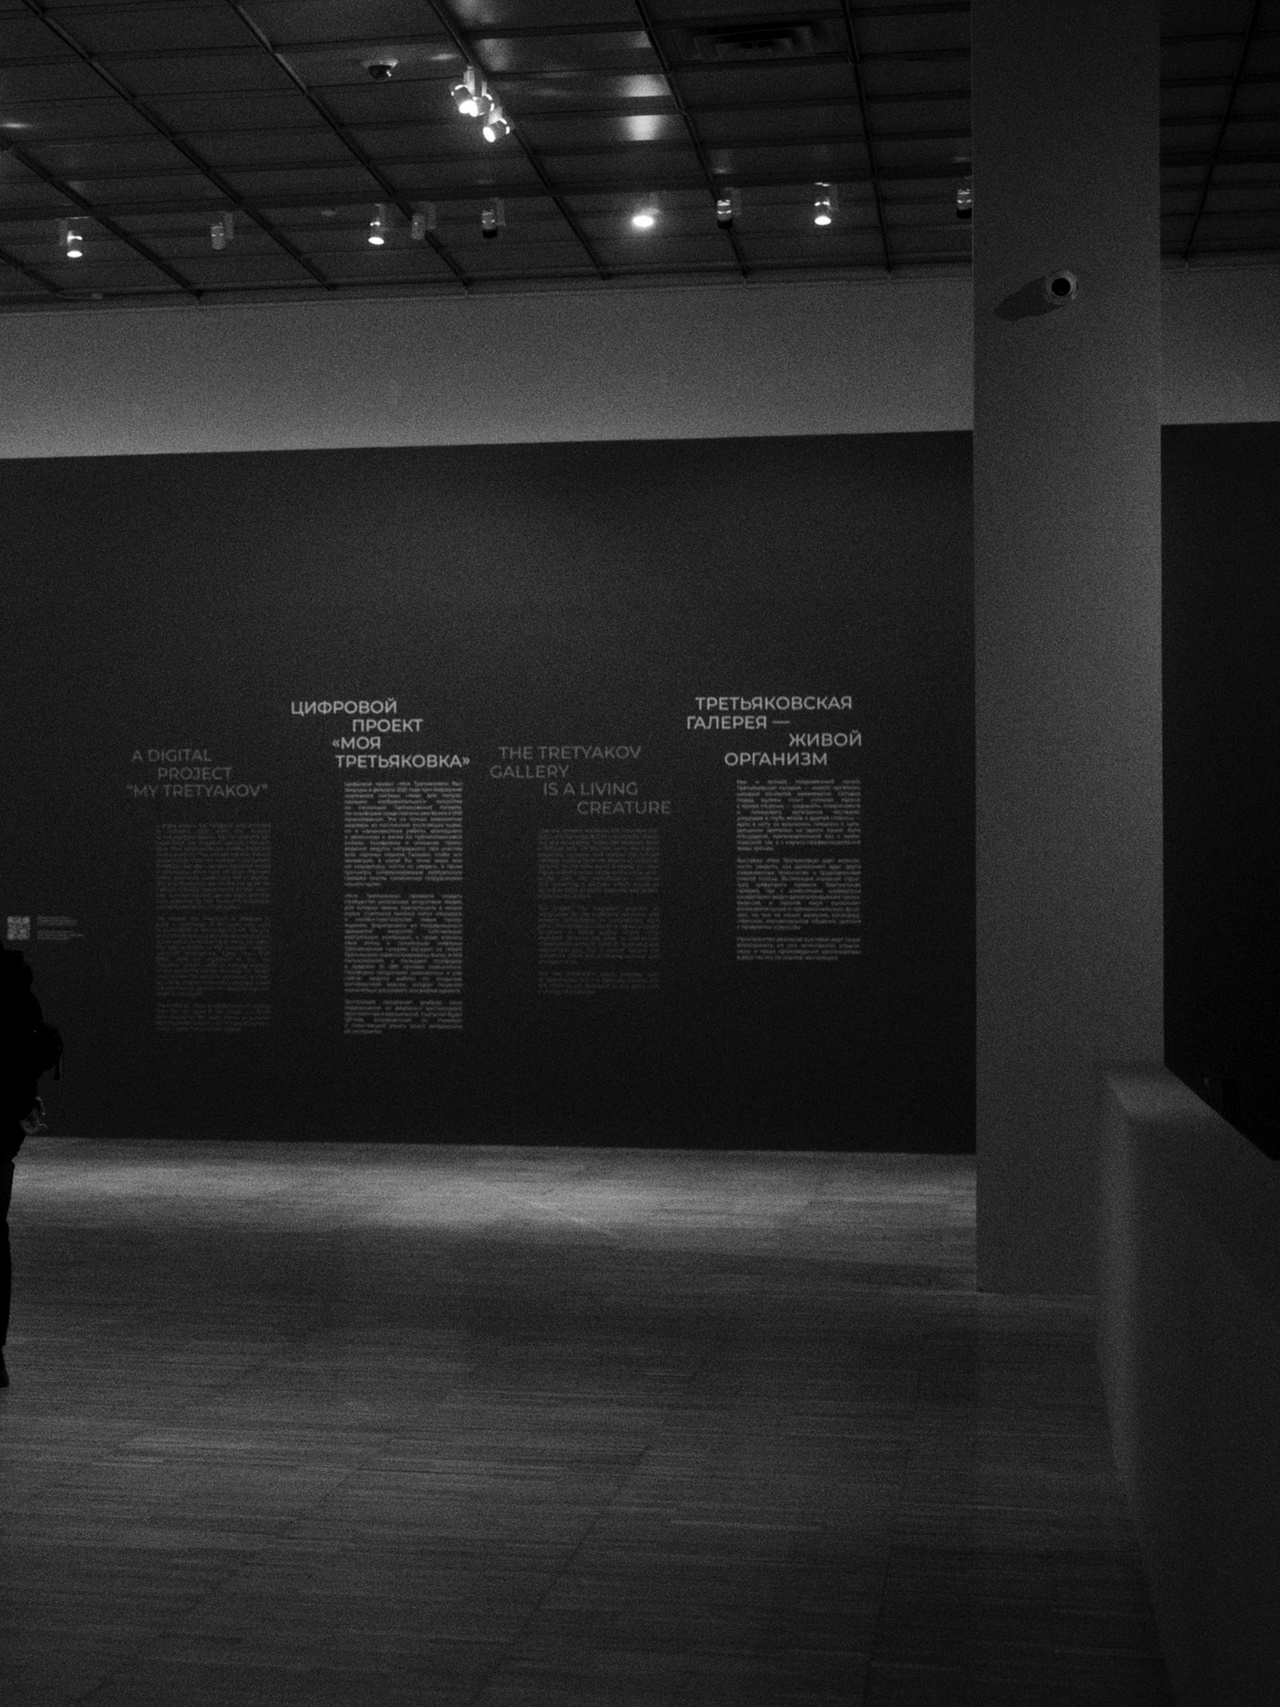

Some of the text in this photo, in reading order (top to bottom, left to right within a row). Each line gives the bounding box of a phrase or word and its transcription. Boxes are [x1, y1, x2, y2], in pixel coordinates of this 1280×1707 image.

[290, 697, 398, 717] ЦИФРОВОЙ
[694, 695, 853, 711] ТРЕТЬЯКОВСКАЯ
[352, 718, 424, 733] ПРОЕКТ
[686, 715, 768, 730] ГАЛЕРЕЯ
[331, 735, 382, 751] «МОЯ
[788, 729, 862, 748] ЖИВОЙ
[131, 748, 213, 763] A DIGITAL
[498, 745, 642, 760] THE TRETYAKOV
[723, 751, 828, 767] ОРГАНИЗМ
[335, 753, 471, 769] ТРЕТЬЯКОВКА»
[157, 765, 233, 781] PROJECT
[489, 763, 570, 780] GALLERY
[542, 780, 639, 797] IS A LIVING
[576, 800, 671, 816] CREATURE
